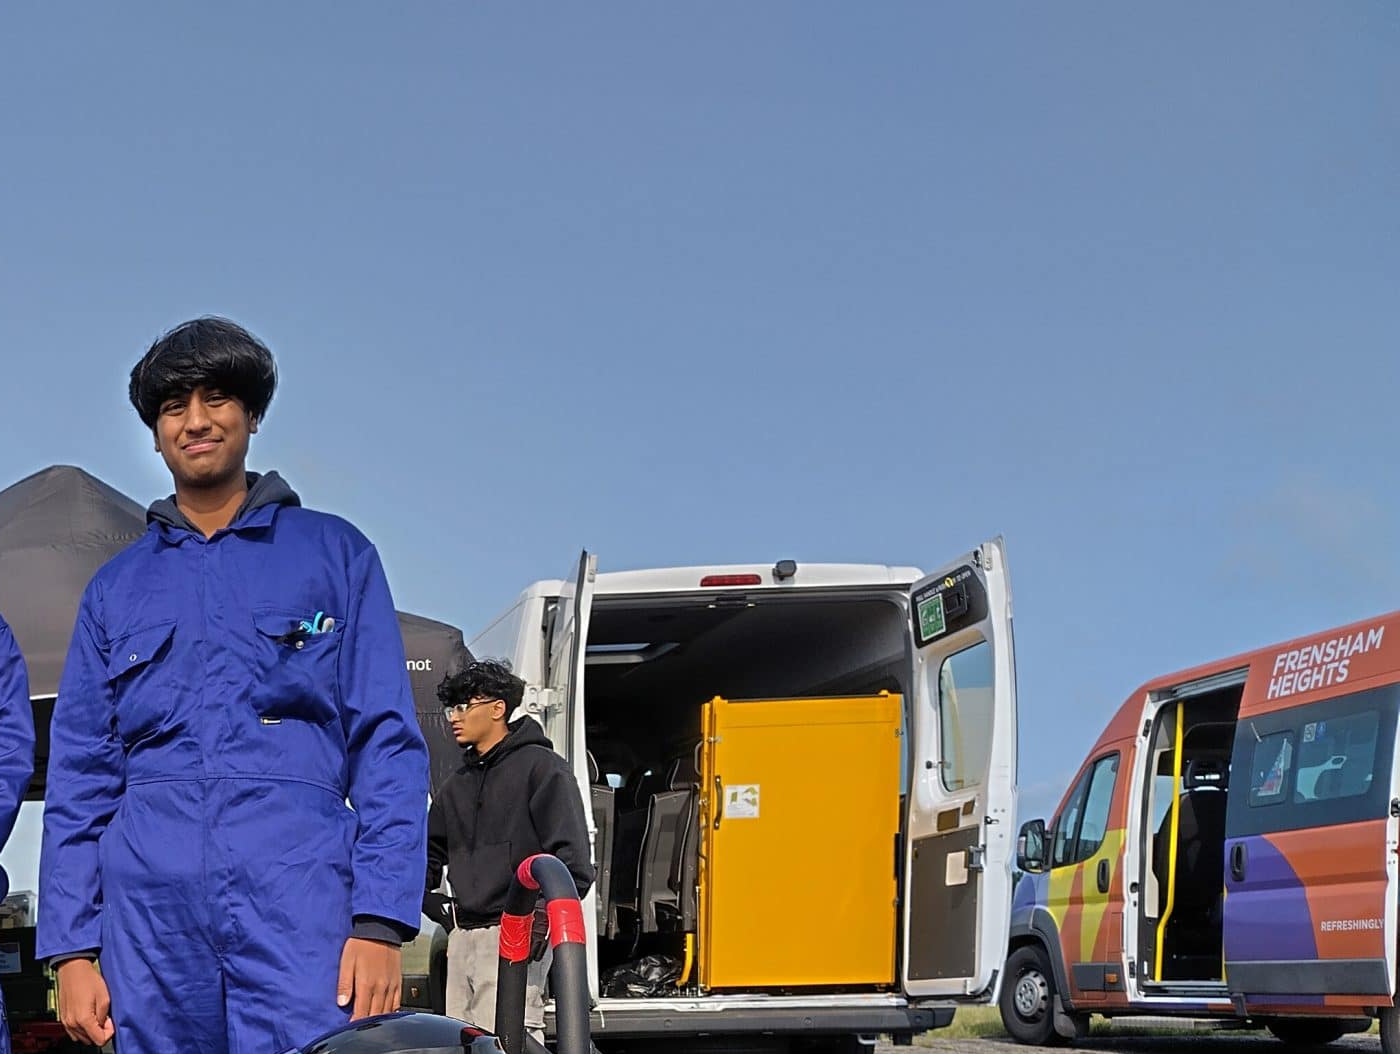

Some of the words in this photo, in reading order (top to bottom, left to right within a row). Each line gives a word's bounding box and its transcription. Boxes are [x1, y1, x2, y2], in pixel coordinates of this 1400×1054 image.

[1272, 625, 1385, 677] FRENSHAM
[406, 659, 432, 671] not
[1267, 659, 1350, 700] HEIGHTS
[1321, 918, 1384, 932] REFRESHINGLY
